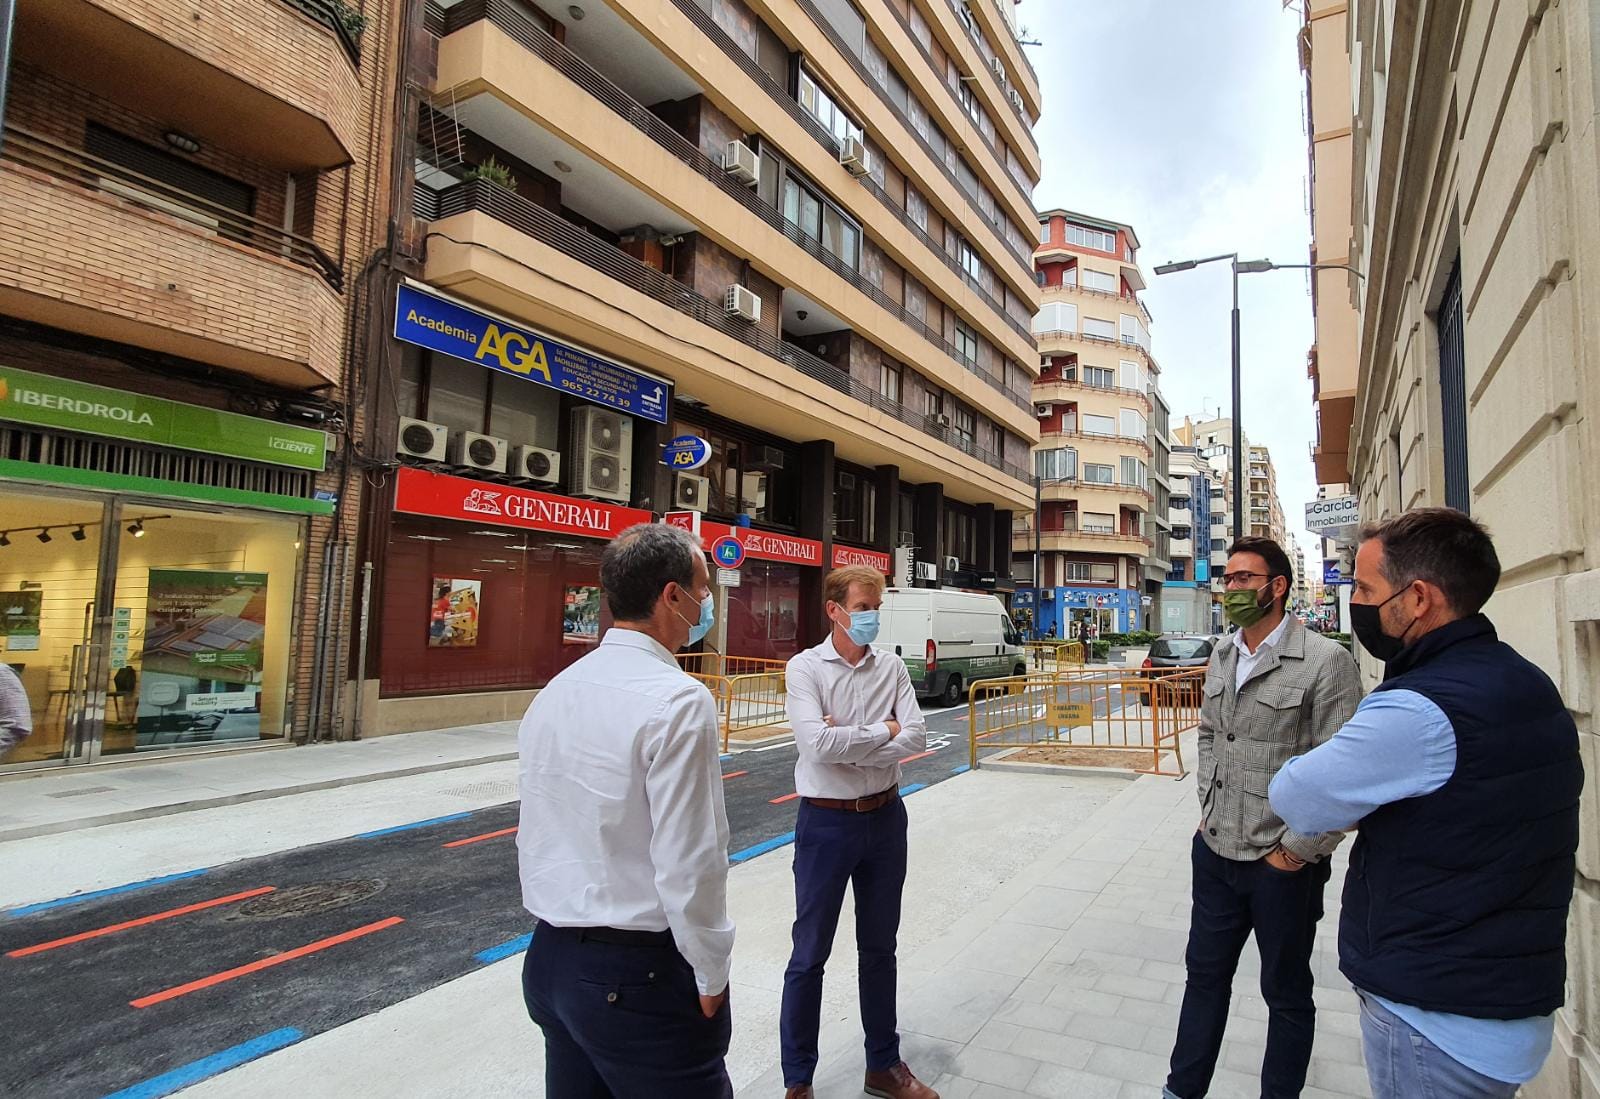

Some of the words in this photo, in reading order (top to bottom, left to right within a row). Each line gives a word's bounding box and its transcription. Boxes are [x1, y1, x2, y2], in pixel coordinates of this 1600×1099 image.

[406, 309, 477, 344] Academia
[474, 323, 552, 382] AGA
[561, 379, 583, 392] 965
[586, 388, 599, 398] 22
[602, 392, 615, 403] 74
[618, 397, 630, 407] 39
[13, 388, 154, 426] IBERDROLA
[273, 441, 316, 455] CLIENTE
[673, 451, 695, 465] AGA
[504, 494, 612, 531] GENERALI
[1313, 498, 1352, 514] García
[762, 535, 816, 560] GENERALI
[849, 552, 889, 571] GENERALI
